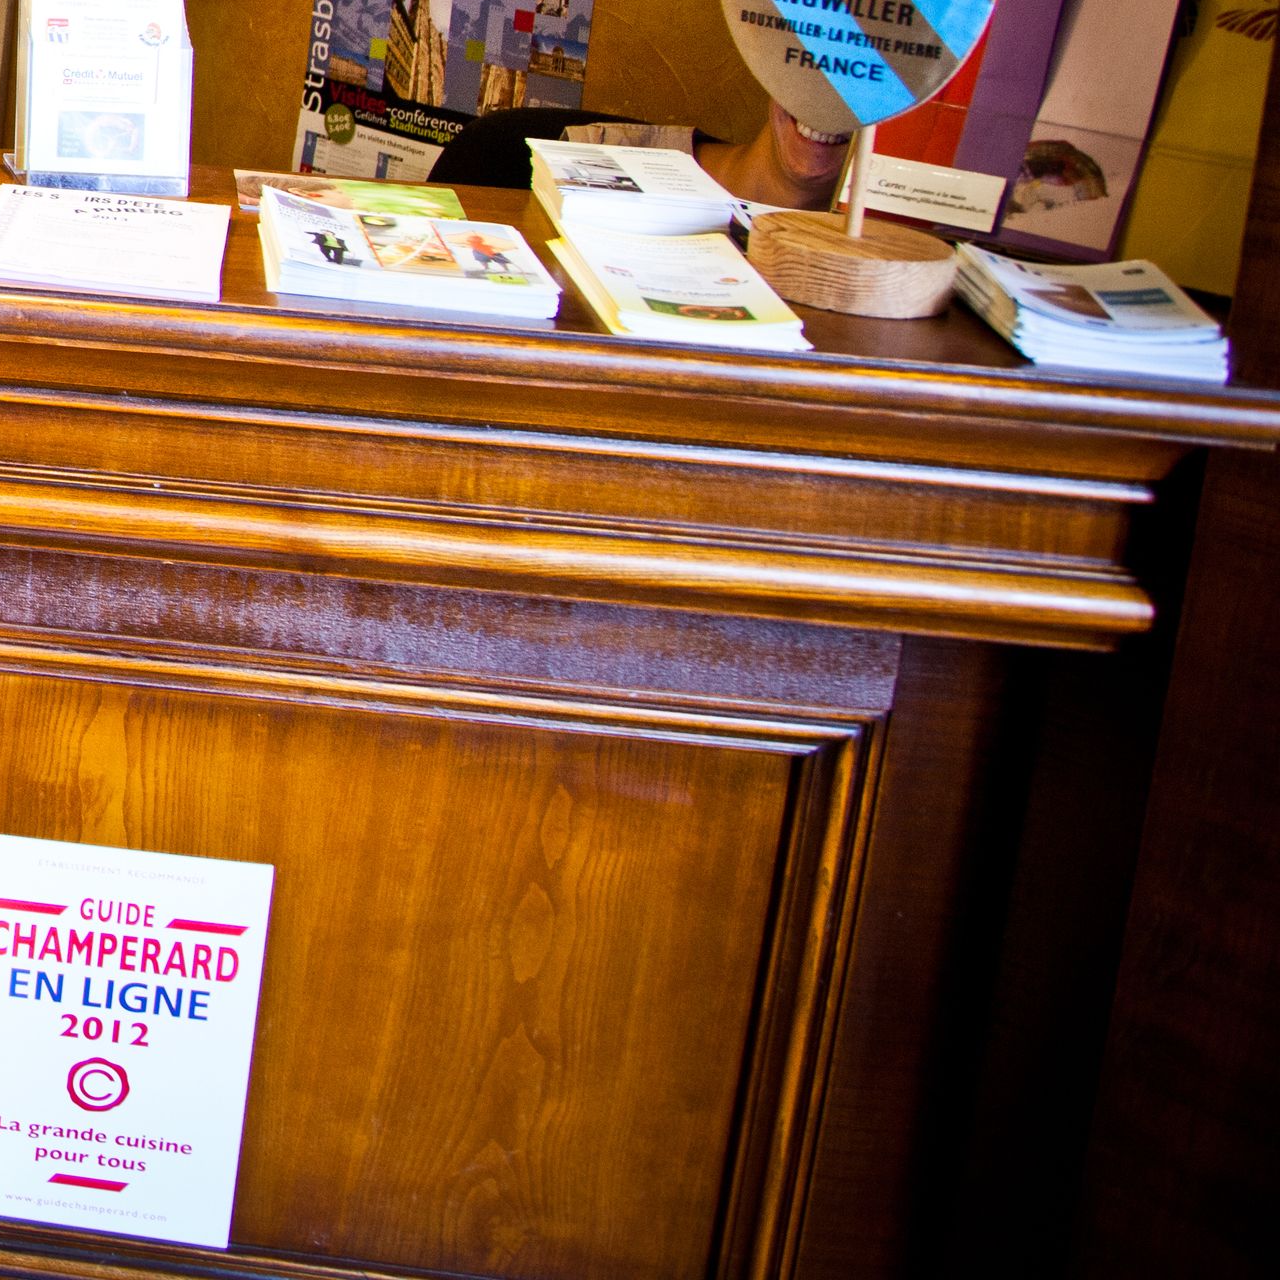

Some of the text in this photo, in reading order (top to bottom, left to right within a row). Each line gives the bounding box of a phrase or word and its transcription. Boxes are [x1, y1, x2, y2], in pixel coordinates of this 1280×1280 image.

[846, 31, 891, 52] PETITE
[893, 40, 943, 60] PIERRE
[63, 68, 144, 81] Crédit Mutuel
[785, 47, 885, 82] FRANCE
[355, 109, 388, 127] Geführte
[357, 131, 426, 157] Les visites thématiques
[11, 188, 44, 198] LES
[878, 178, 906, 191] Cartes
[91, 207, 185, 217] PUBERG
[79, 897, 156, 928] GUIDE
[8, 967, 212, 1022] EN LIGNE
[59, 1013, 150, 1048] 2012
[27, 1120, 108, 1145] grande
[114, 1133, 194, 1156] cuisine
[34, 1145, 148, 1173] pour tous
[4, 1191, 168, 1223] www.guidechamperard.com
